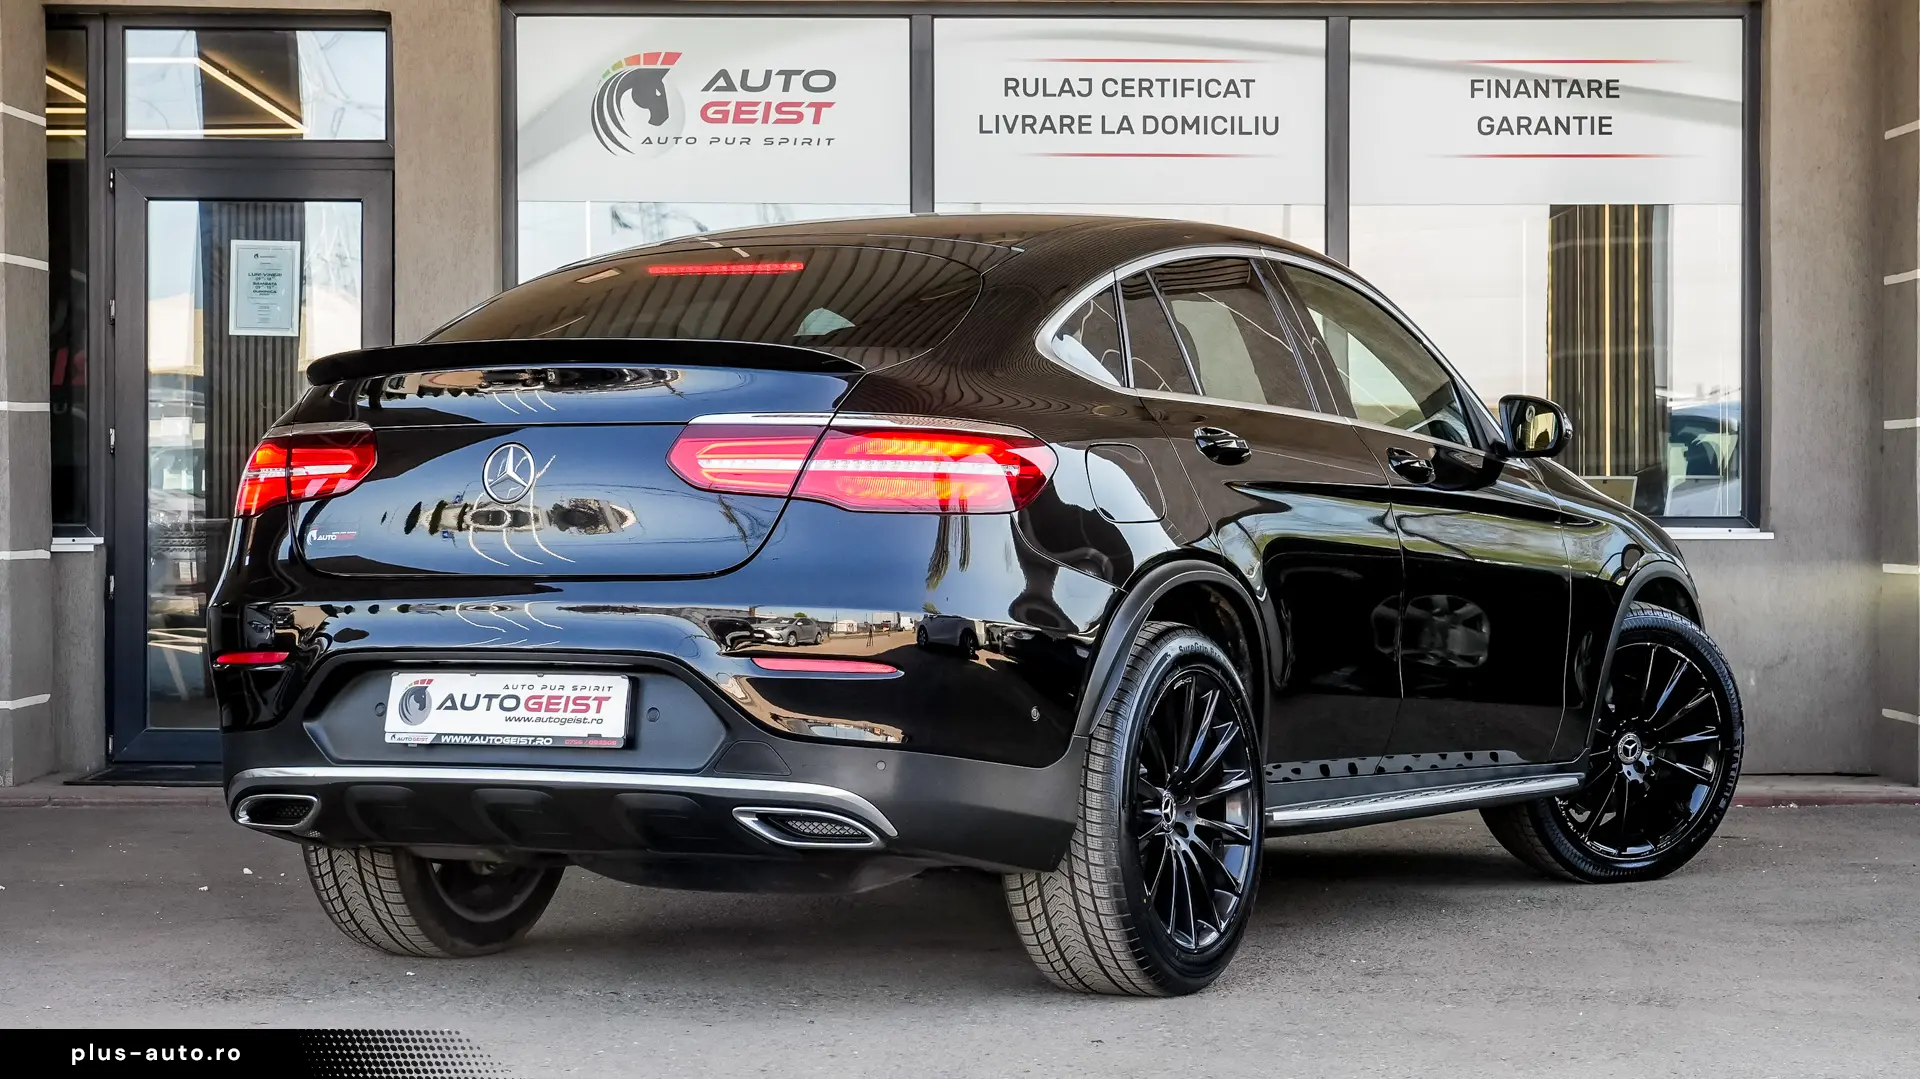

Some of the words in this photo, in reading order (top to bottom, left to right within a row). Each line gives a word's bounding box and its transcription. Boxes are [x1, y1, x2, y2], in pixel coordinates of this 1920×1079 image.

[700, 68, 837, 93] AUTO
[1003, 77, 1093, 98] RULAJ
[1101, 77, 1256, 99] CERTIFICAT
[1470, 78, 1620, 99] FINANTARE
[699, 100, 837, 125] GEIST
[978, 114, 1093, 135] LIVRARE
[1100, 114, 1135, 135] LA
[1142, 115, 1280, 136] DOMICILIU
[1477, 115, 1613, 136] GARANTIE
[640, 136, 698, 145] AUTO
[709, 136, 751, 146] PUR
[763, 136, 836, 147] SPIRIT
[502, 683, 535, 691] AUTO
[540, 684, 566, 692] PUR
[571, 685, 614, 693] SPIRIT
[436, 692, 612, 715] AUTOGEIST
[504, 714, 604, 726] www.autogeist.ro
[440, 733, 553, 746] WWW.AUTOGEIST.RO
